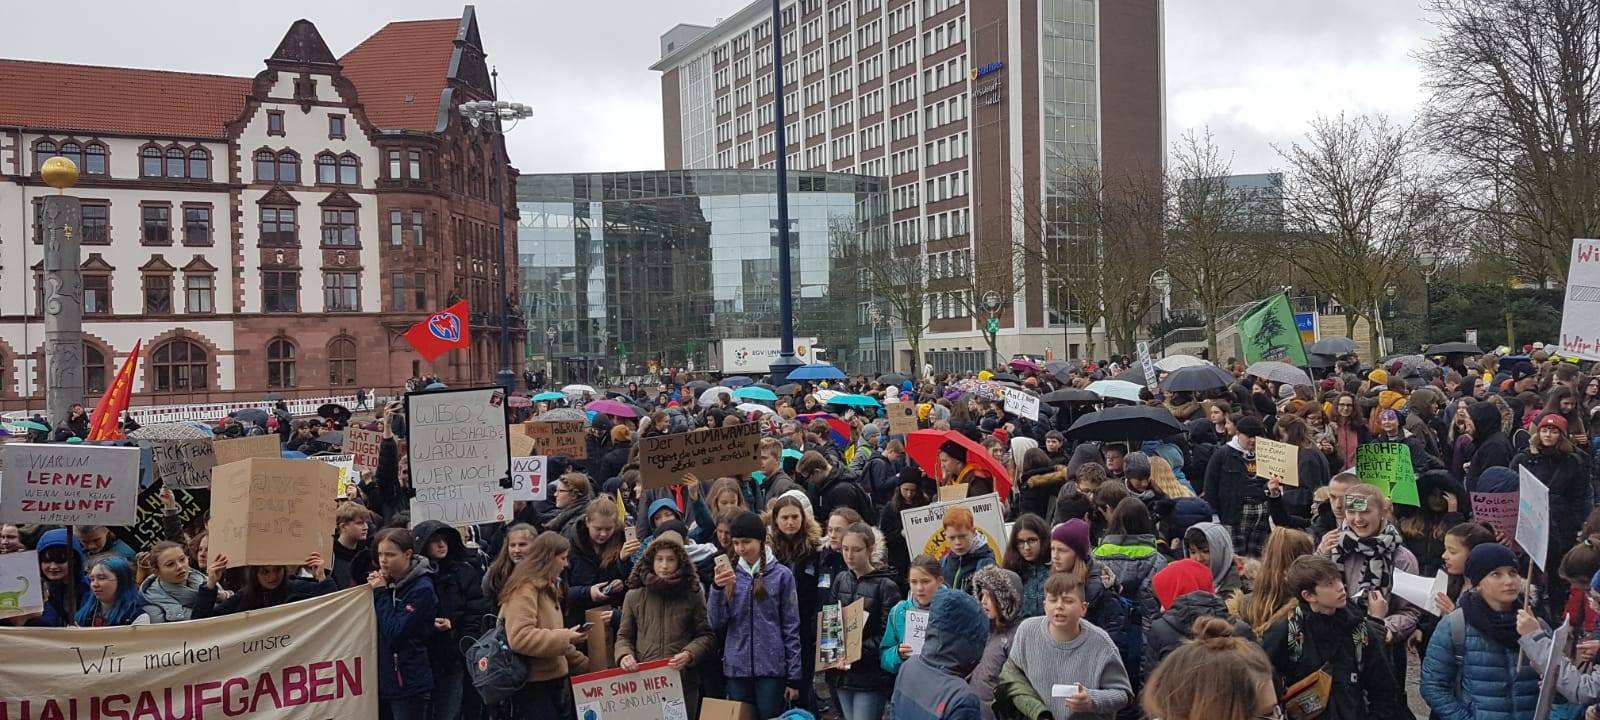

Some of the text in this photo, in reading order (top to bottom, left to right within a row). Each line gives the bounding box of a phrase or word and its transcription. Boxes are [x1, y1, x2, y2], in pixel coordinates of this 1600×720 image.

[1578, 243, 1600, 263] Wi
[349, 430, 369, 442] HAT
[154, 441, 190, 460] FICKT
[647, 437, 674, 451] Der
[27, 454, 90, 469] WARUM
[514, 458, 540, 471] NO
[1356, 461, 1393, 472] HEUTE
[27, 470, 112, 489] LERNEN
[416, 464, 495, 484] WER NOCH
[21, 499, 115, 513] ZUKUNFT
[910, 515, 922, 526] Für
[70, 631, 291, 675] Wir machen unsre
[0, 656, 364, 720] HAUSAUFGABEN
[582, 675, 673, 698] WIR SIND HIER,
[600, 701, 616, 713] WIR
